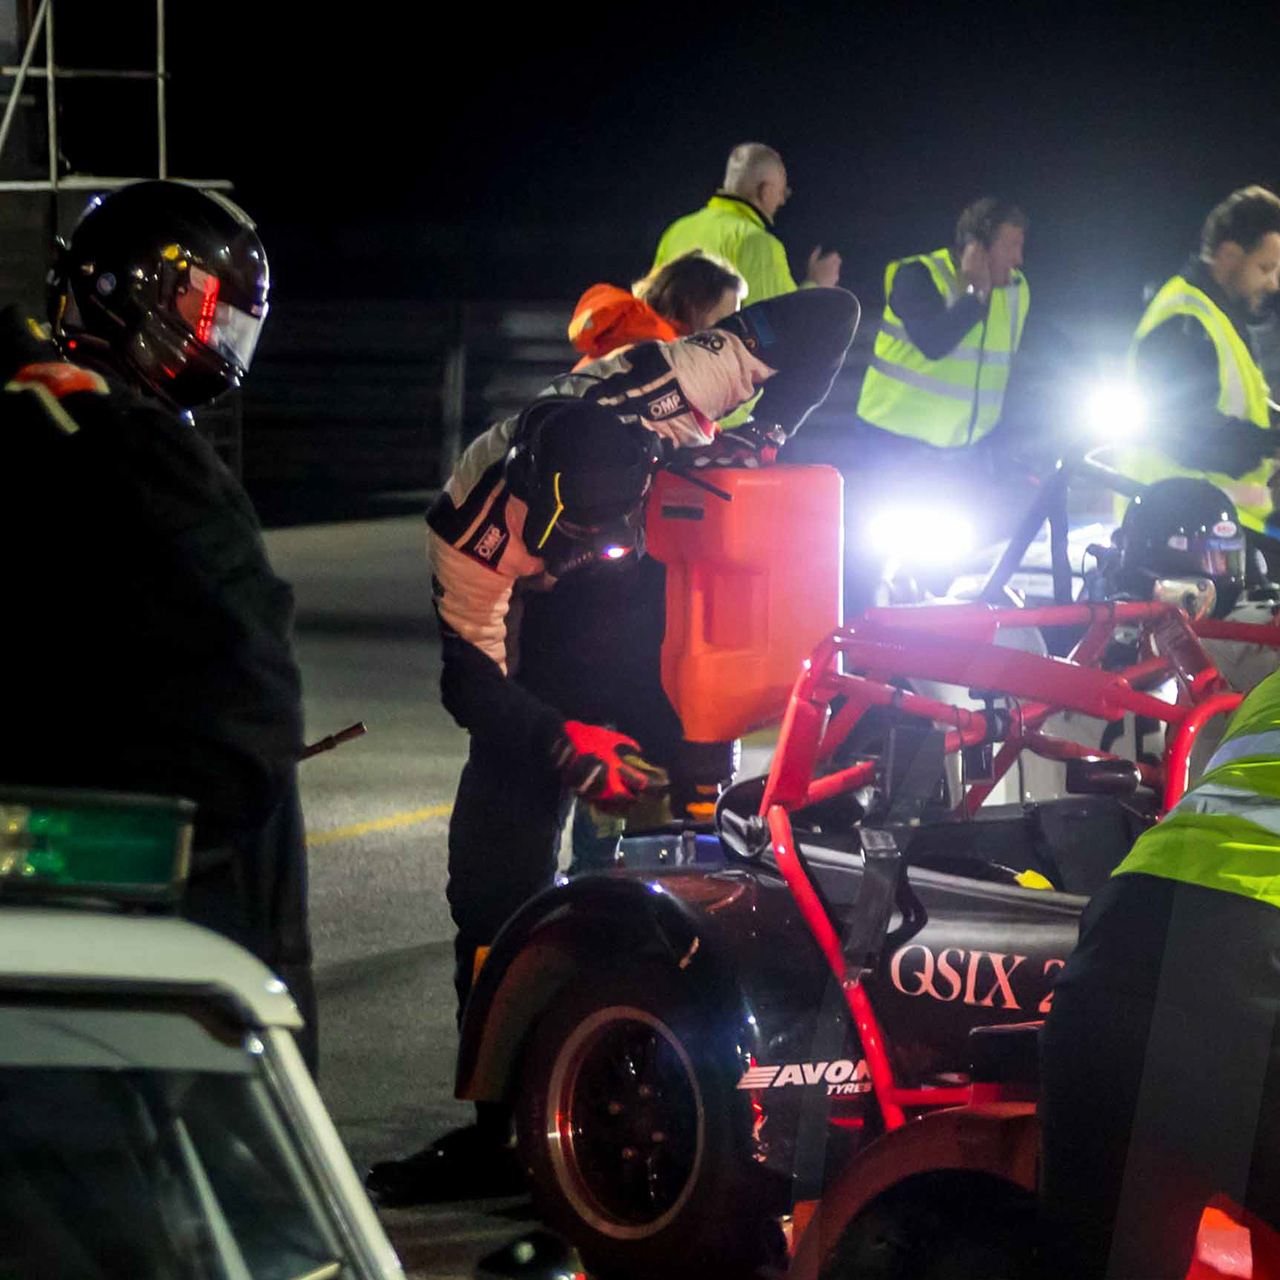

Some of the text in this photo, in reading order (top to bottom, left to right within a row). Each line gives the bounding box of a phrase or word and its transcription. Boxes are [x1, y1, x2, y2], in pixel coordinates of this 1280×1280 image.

[650, 394, 682, 418] OMP
[477, 526, 502, 559] OMP
[891, 944, 1028, 1010] QSIX
[827, 1083, 873, 1095] TYRES
